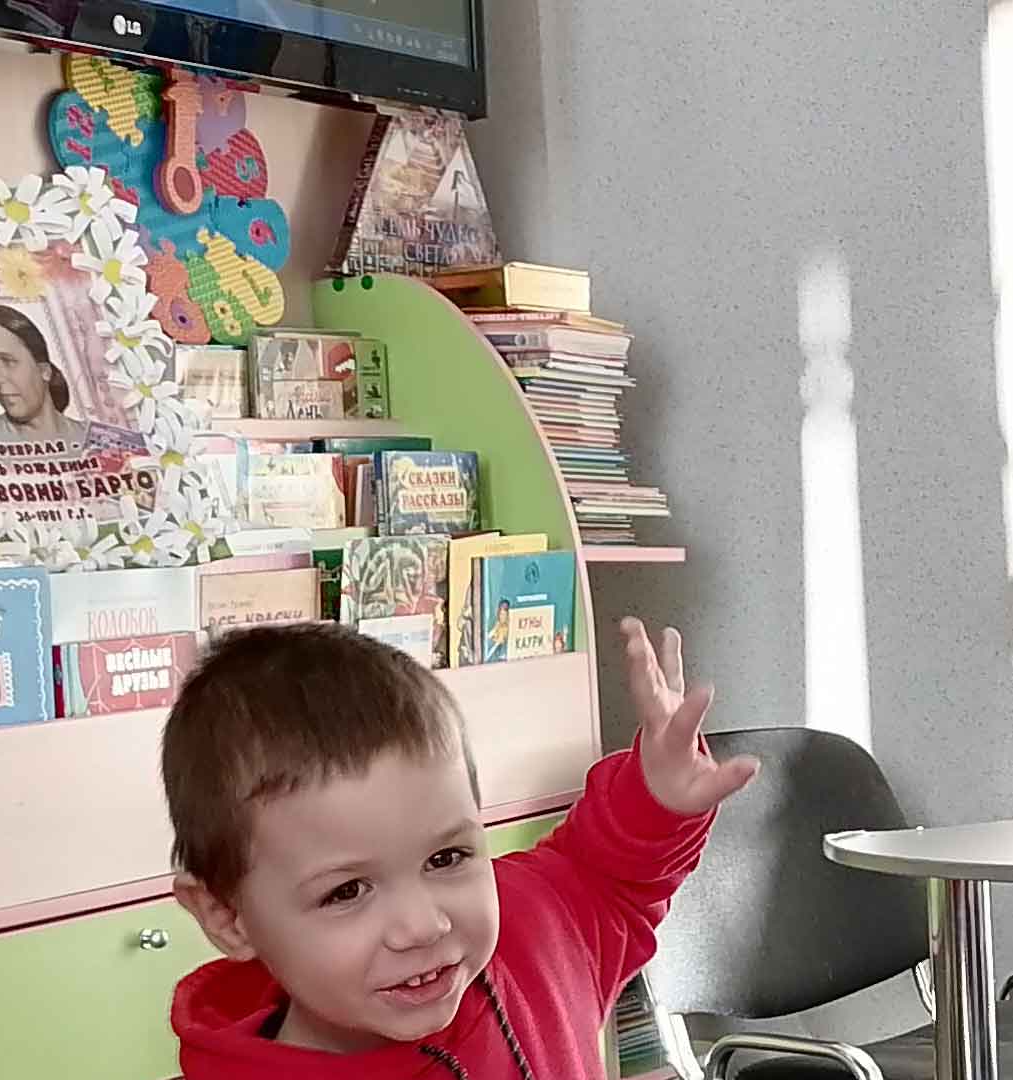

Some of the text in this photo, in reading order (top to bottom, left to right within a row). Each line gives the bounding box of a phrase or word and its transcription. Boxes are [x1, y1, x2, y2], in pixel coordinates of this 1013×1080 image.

[14, 456, 100, 476] РОЖДЕНИЯ
[77, 470, 155, 499] БАРТО
[408, 470, 457, 485] СКАЗКИ
[401, 492, 465, 508] РАССКАЗЫ
[110, 669, 171, 697] ДРУЗЬЯ
